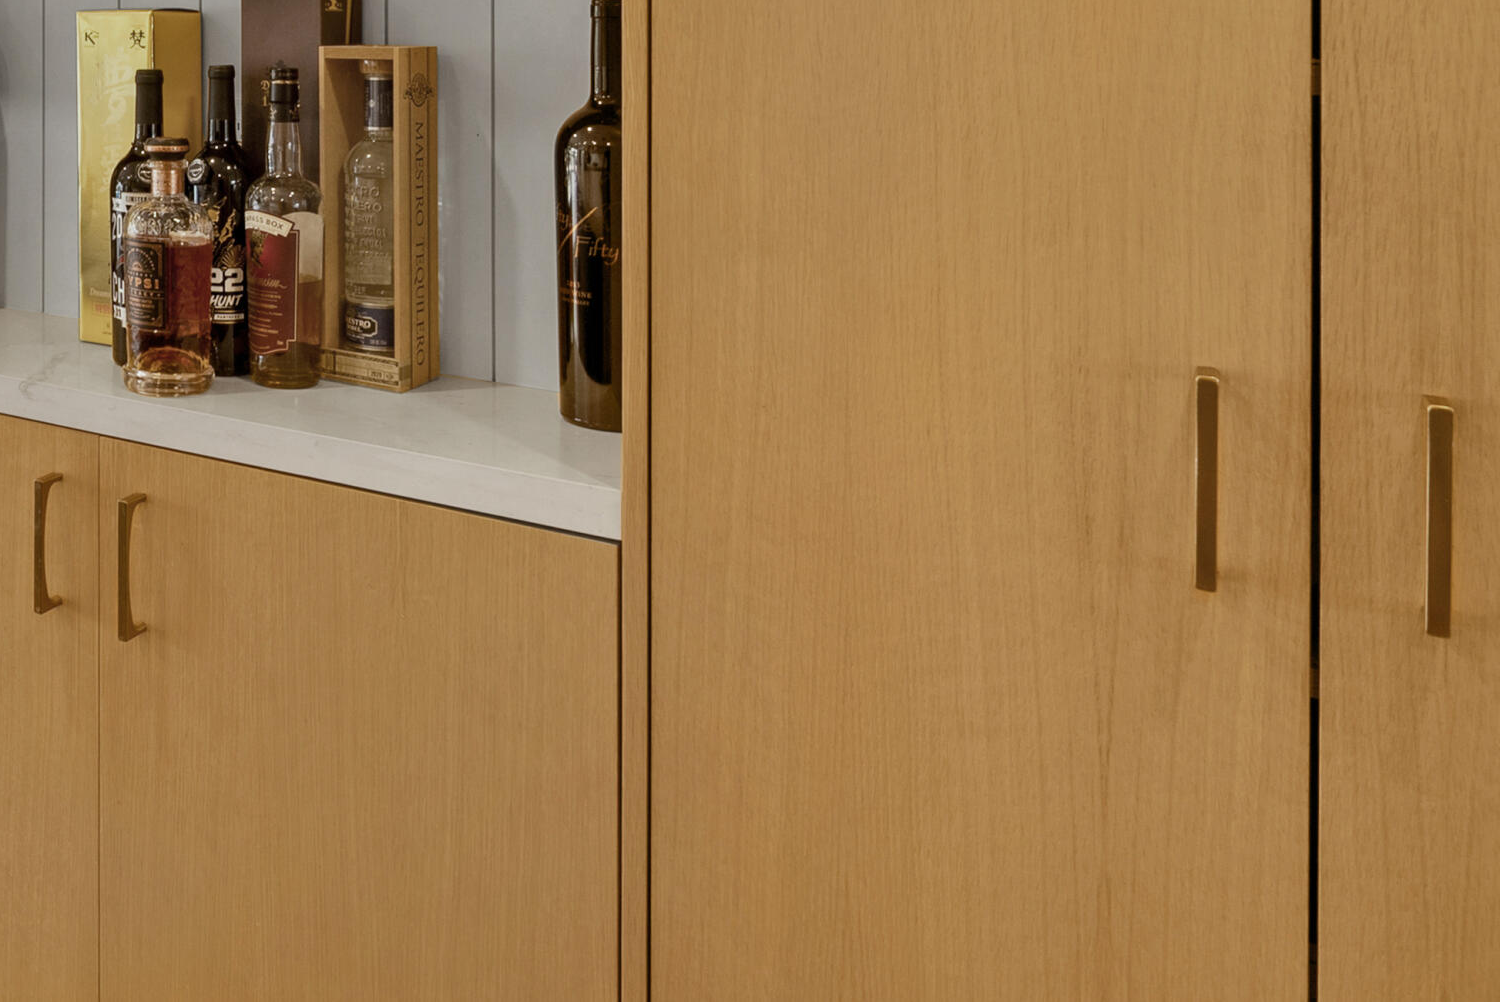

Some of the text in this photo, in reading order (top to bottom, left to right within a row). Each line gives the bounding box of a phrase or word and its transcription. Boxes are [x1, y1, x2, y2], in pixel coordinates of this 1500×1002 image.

[265, 218, 284, 230] BOX
[413, 121, 426, 367] MAESTRO TEQUILERO
[574, 235, 619, 266] Fifty
[210, 267, 244, 292] 22
[210, 294, 244, 307] HUNT
